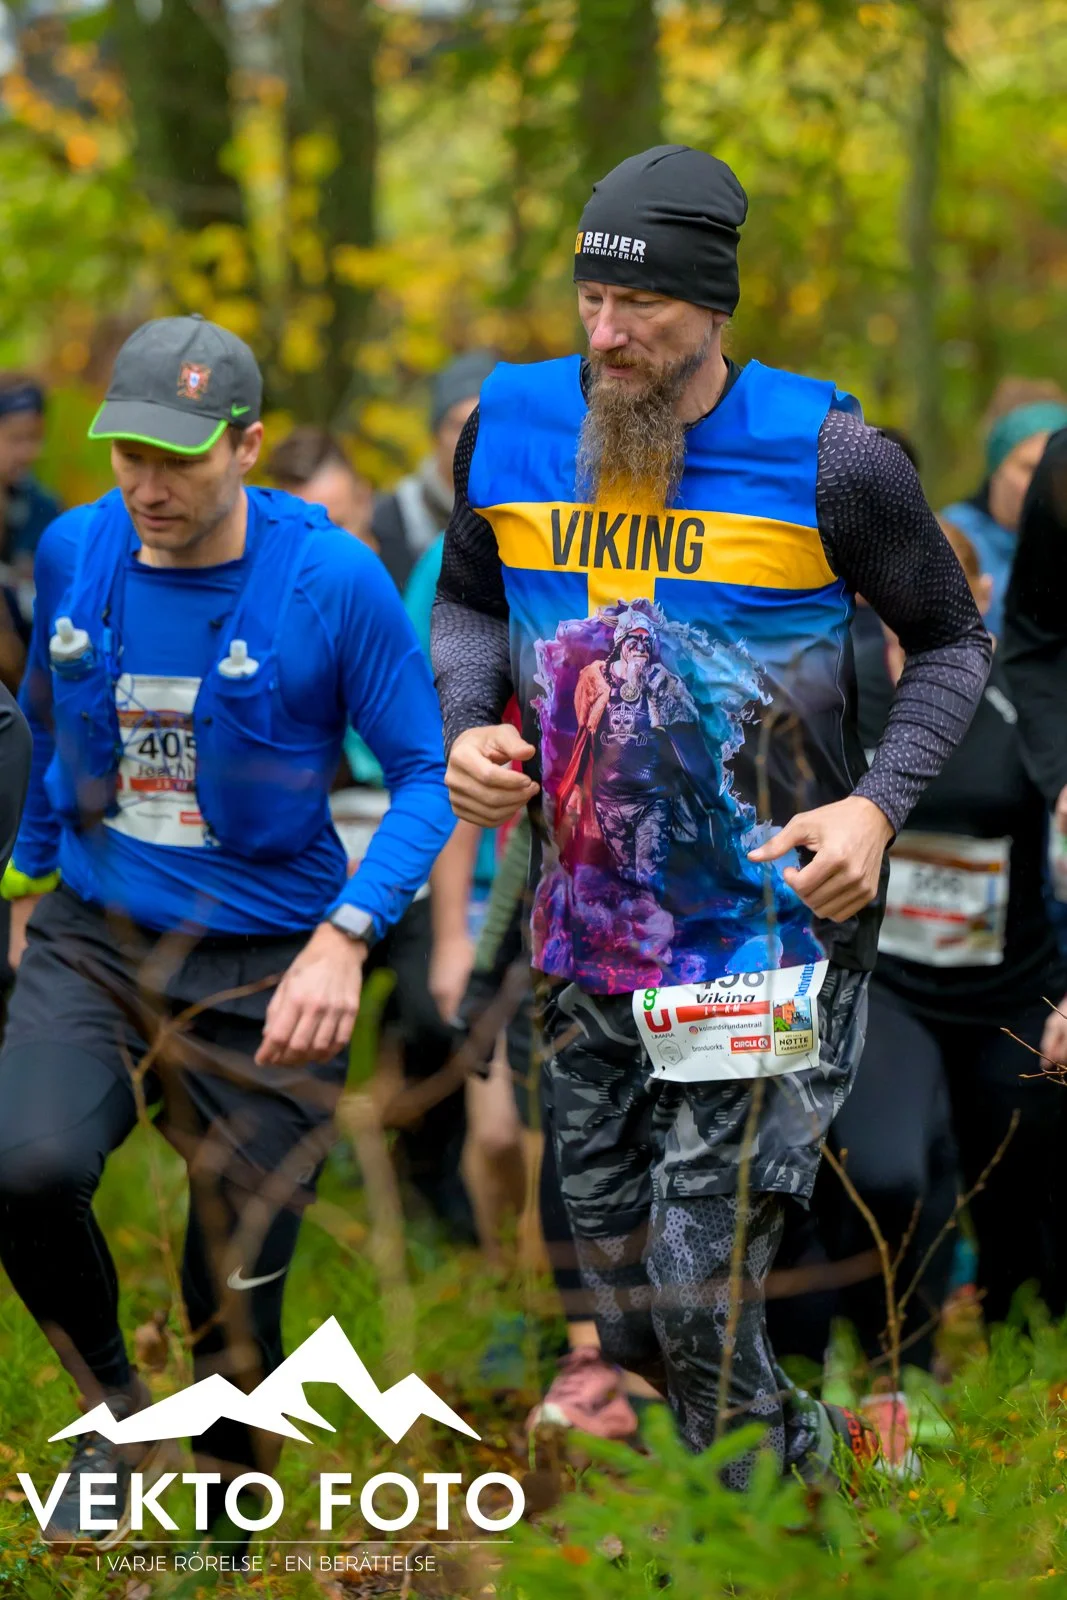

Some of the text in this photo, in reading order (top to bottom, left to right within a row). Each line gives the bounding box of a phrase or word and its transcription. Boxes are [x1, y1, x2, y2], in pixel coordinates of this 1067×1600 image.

[583, 231, 647, 256] BEIJER
[582, 247, 645, 263] BYGGMATERIAL
[551, 508, 705, 574] VIKING
[138, 732, 196, 761] 405
[137, 762, 194, 778] Joachi
[695, 991, 756, 1005] Viking
[724, 1003, 741, 1014] KM
[733, 1040, 757, 1048] CIRCLE
[779, 1037, 808, 1046] NØTTE
